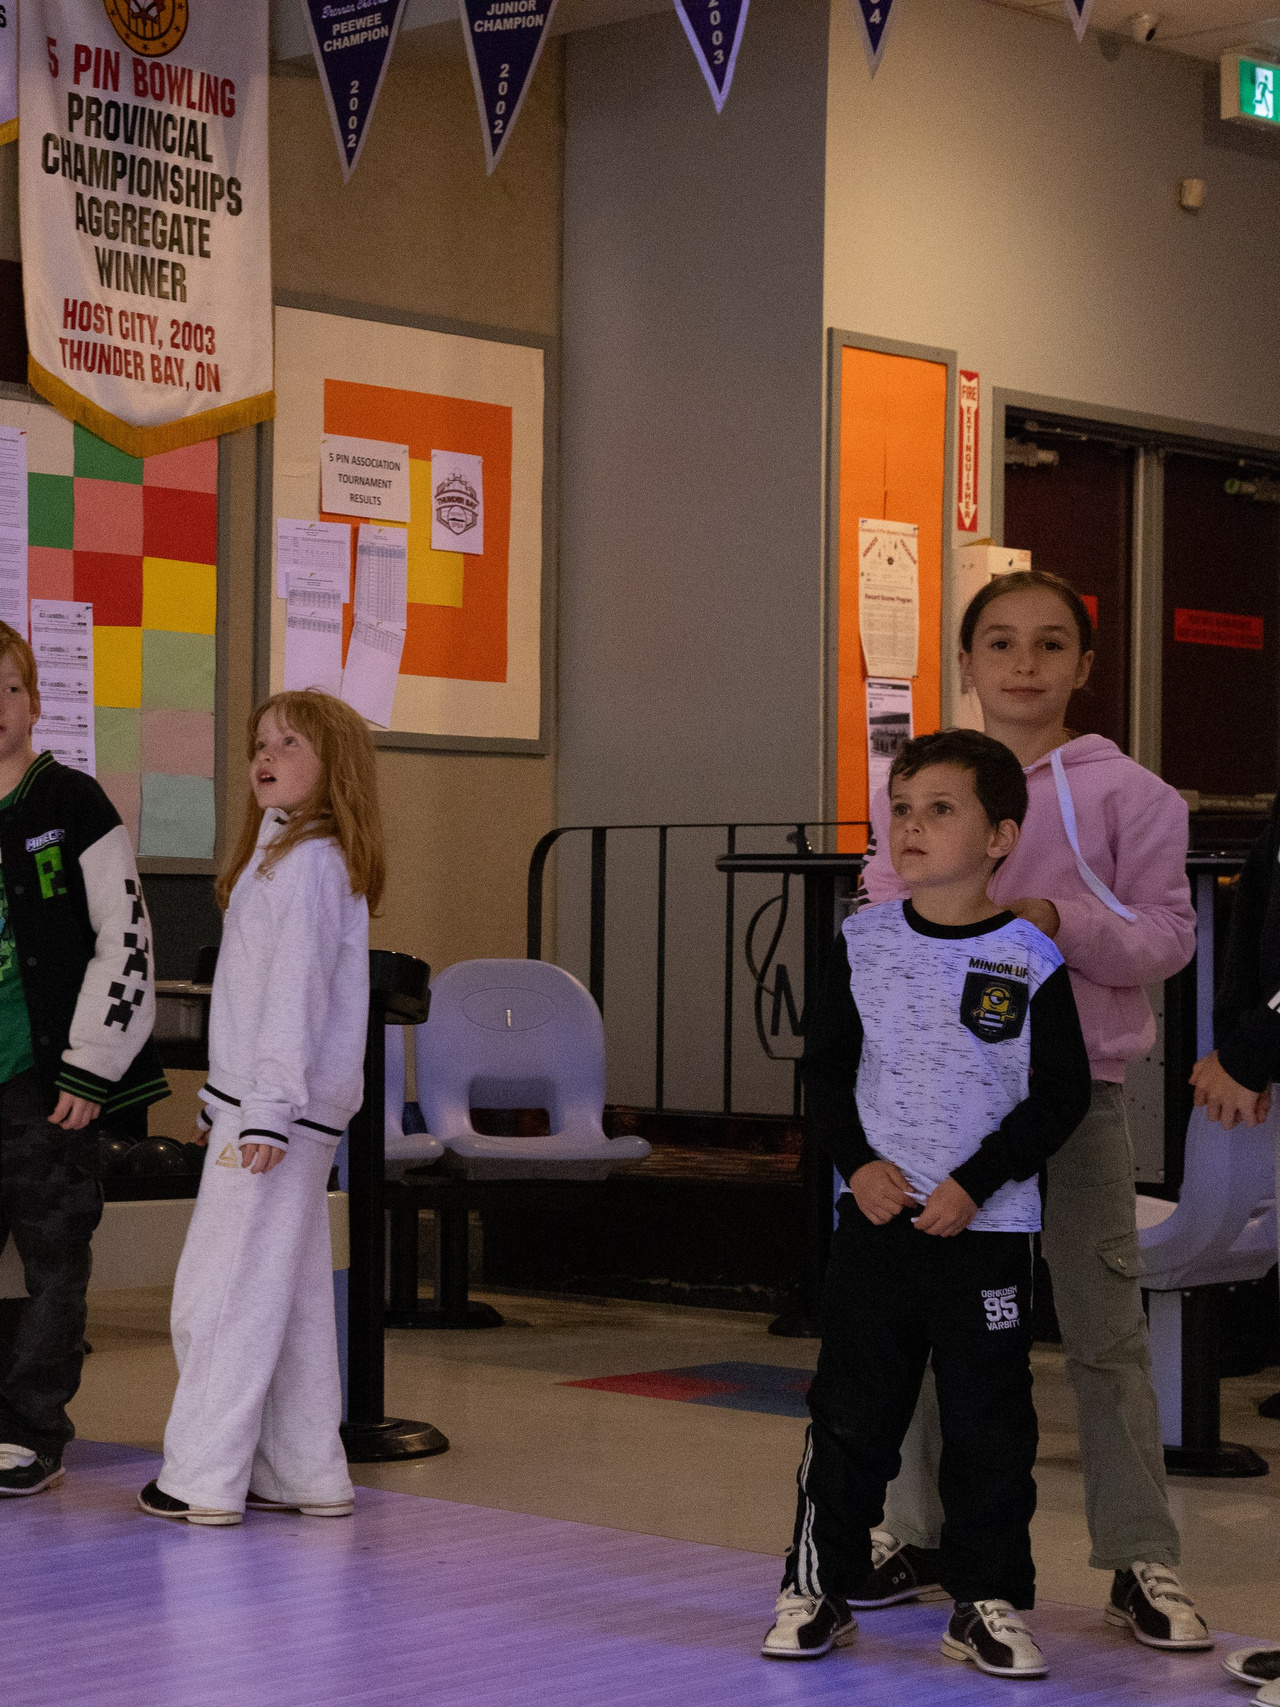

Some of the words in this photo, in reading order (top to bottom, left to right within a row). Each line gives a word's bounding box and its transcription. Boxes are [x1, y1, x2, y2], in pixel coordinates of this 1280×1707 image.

[487, 0, 537, 16] JUNIOR
[332, 12, 382, 36] PEEWEE
[473, 14, 544, 33] CHAMPION
[323, 25, 389, 52] CHAMPION
[47, 37, 59, 78] 5
[73, 44, 120, 92] PIN
[132, 57, 236, 118] BOWLING
[493, 63, 510, 134] 2002
[67, 92, 213, 163] PROVINCIAL
[347, 80, 360, 148] 2002
[41, 133, 243, 217] CHAMPIONSHIPS
[75, 192, 211, 259] AGGREGATE
[94, 246, 187, 303] WINNER
[63, 298, 113, 336] HOST
[119, 311, 164, 349] CITY,
[170, 320, 216, 355] 2003
[59, 337, 146, 382] THUNDER
[151, 354, 190, 390] BAY,
[195, 361, 221, 393] ON
[328, 452, 335, 463] 5
[336, 453, 350, 465] PIN
[351, 456, 401, 471] ASSOCIATION
[338, 473, 392, 489] TOURNAMENT
[350, 493, 382, 506] RESULTS
[968, 957, 1013, 976] MINION
[981, 1285, 1018, 1298] OSHKOSH
[983, 1294, 1019, 1322] 95
[986, 1318, 1021, 1331] VARSITY
